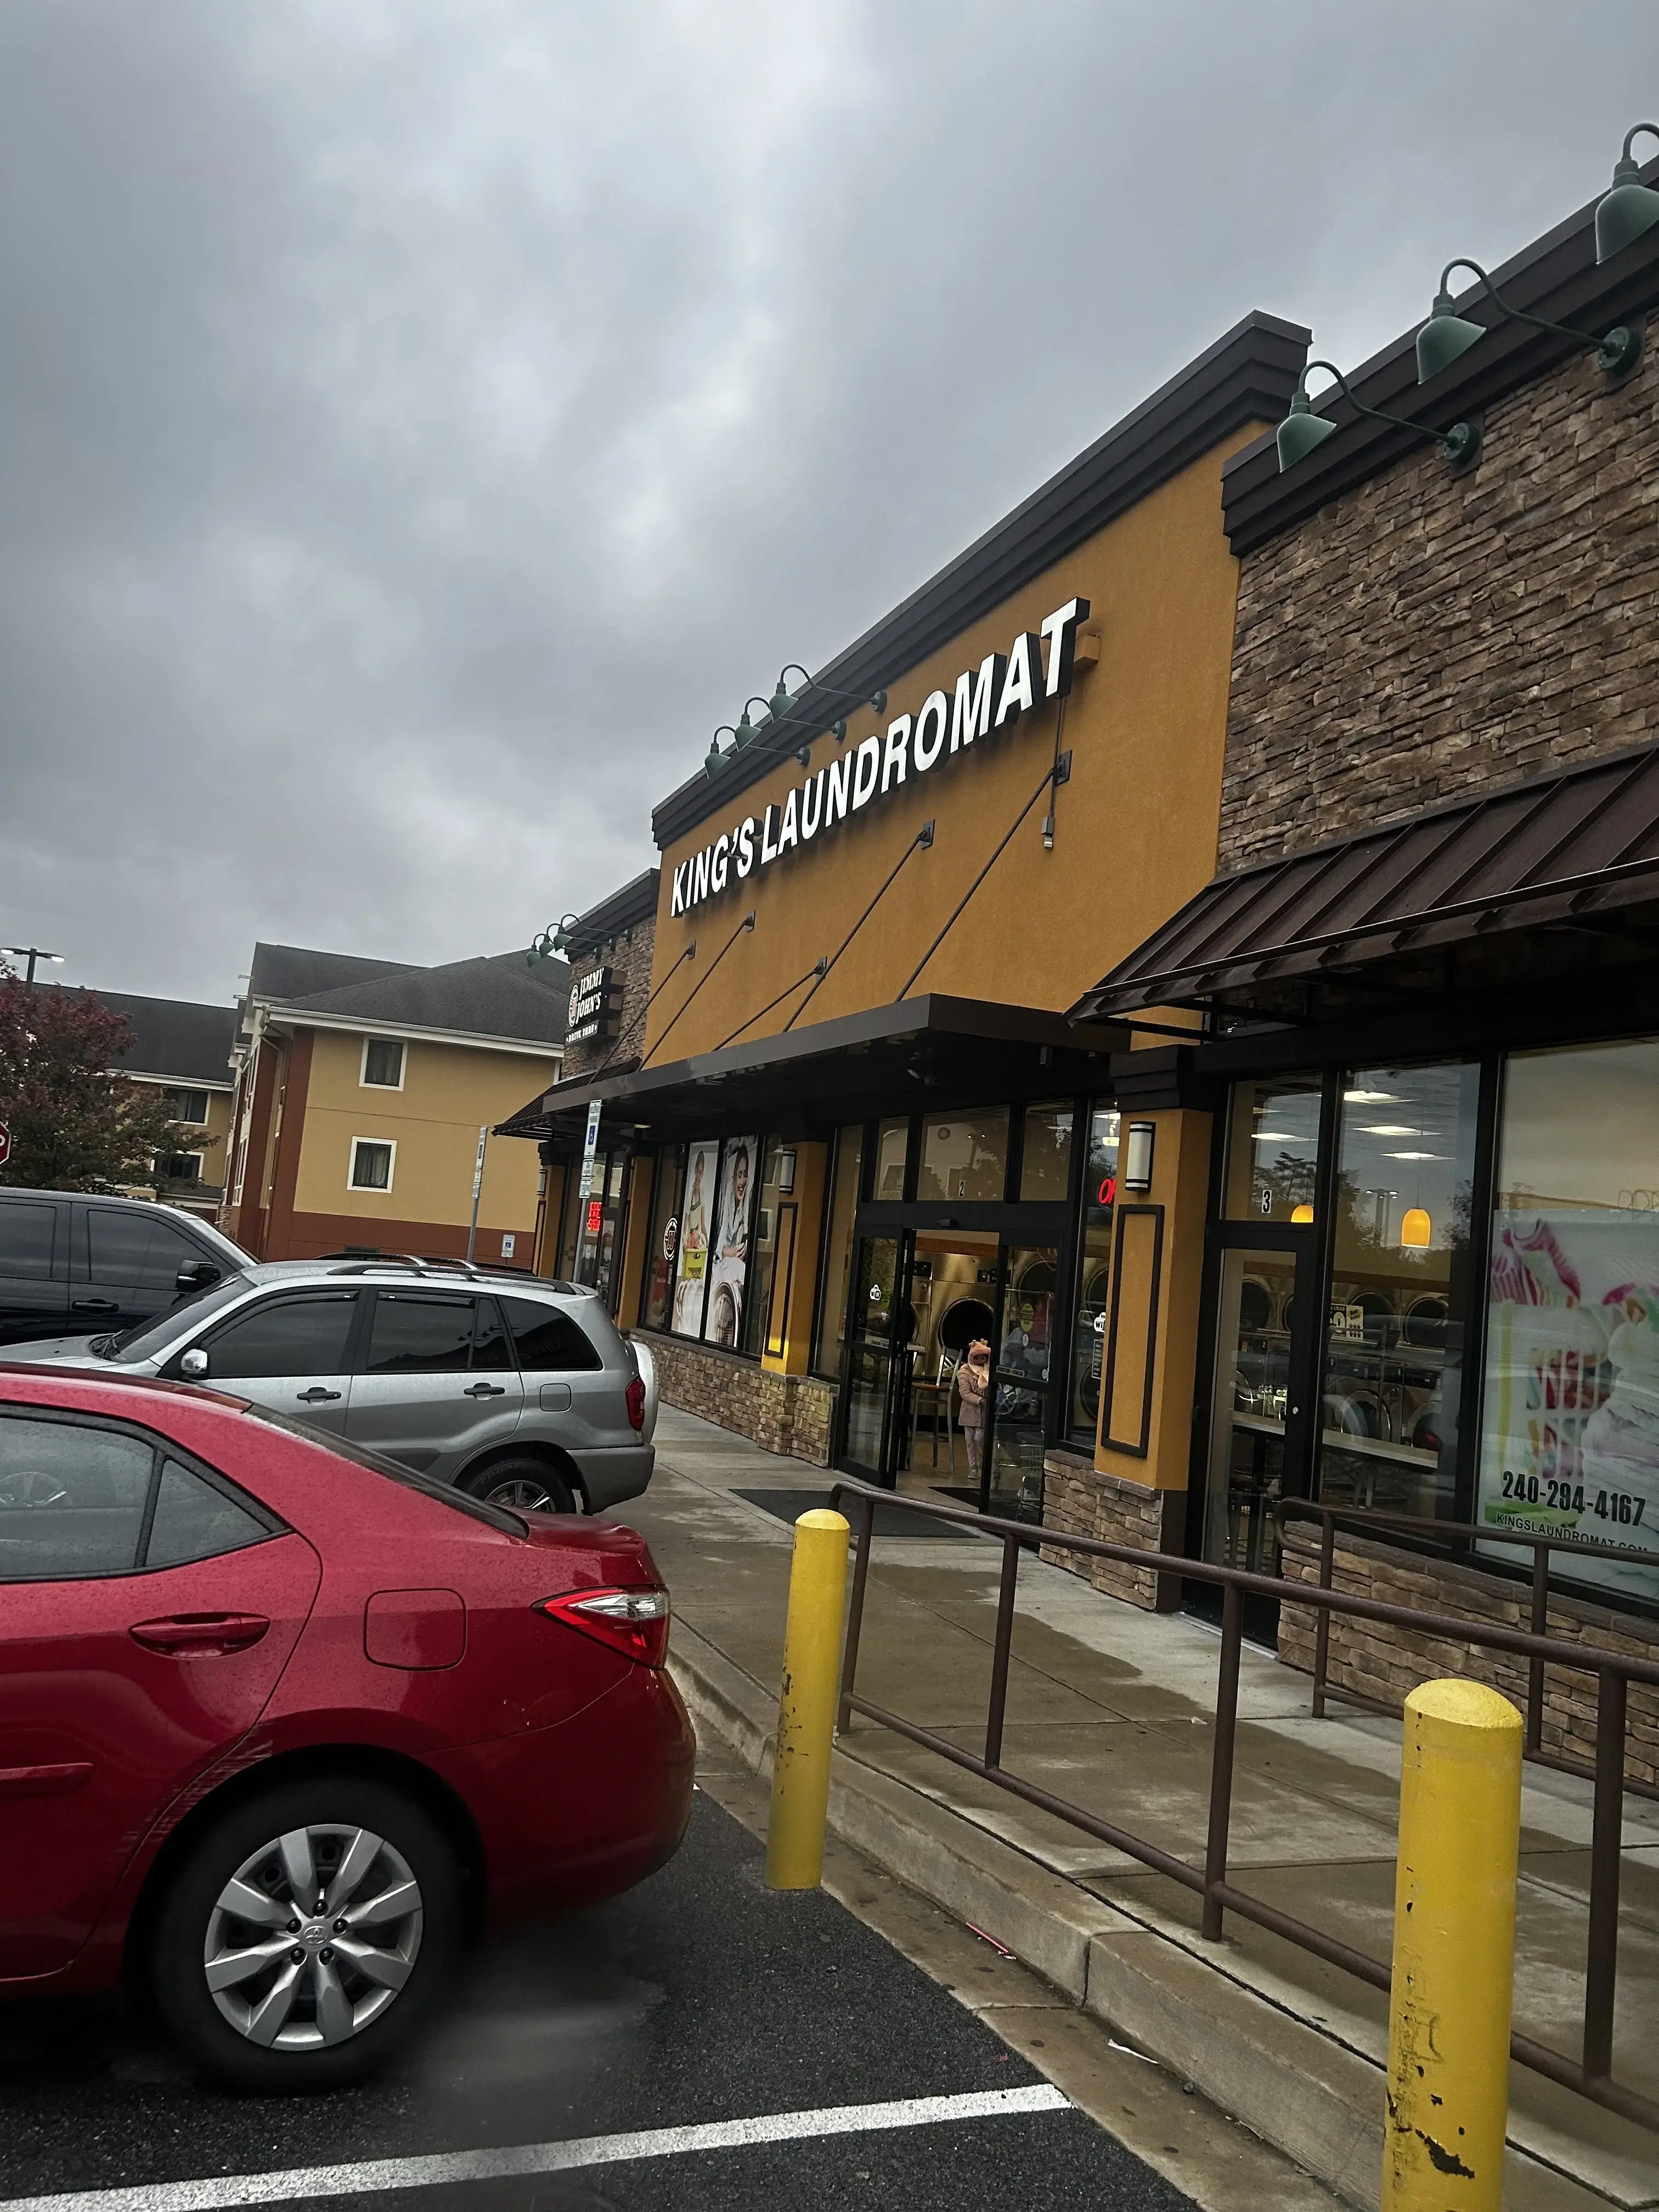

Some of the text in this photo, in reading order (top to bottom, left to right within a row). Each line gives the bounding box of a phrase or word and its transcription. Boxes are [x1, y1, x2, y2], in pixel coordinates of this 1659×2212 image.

[671, 597, 1081, 917] KING'S LAUNDROMAT
[579, 967, 605, 1001] JIMMY
[575, 991, 602, 1025] JOHN'S
[960, 1181, 964, 1197] 2
[1263, 1190, 1271, 1212] 3
[1502, 1471, 1646, 1526] 240-294-4167
